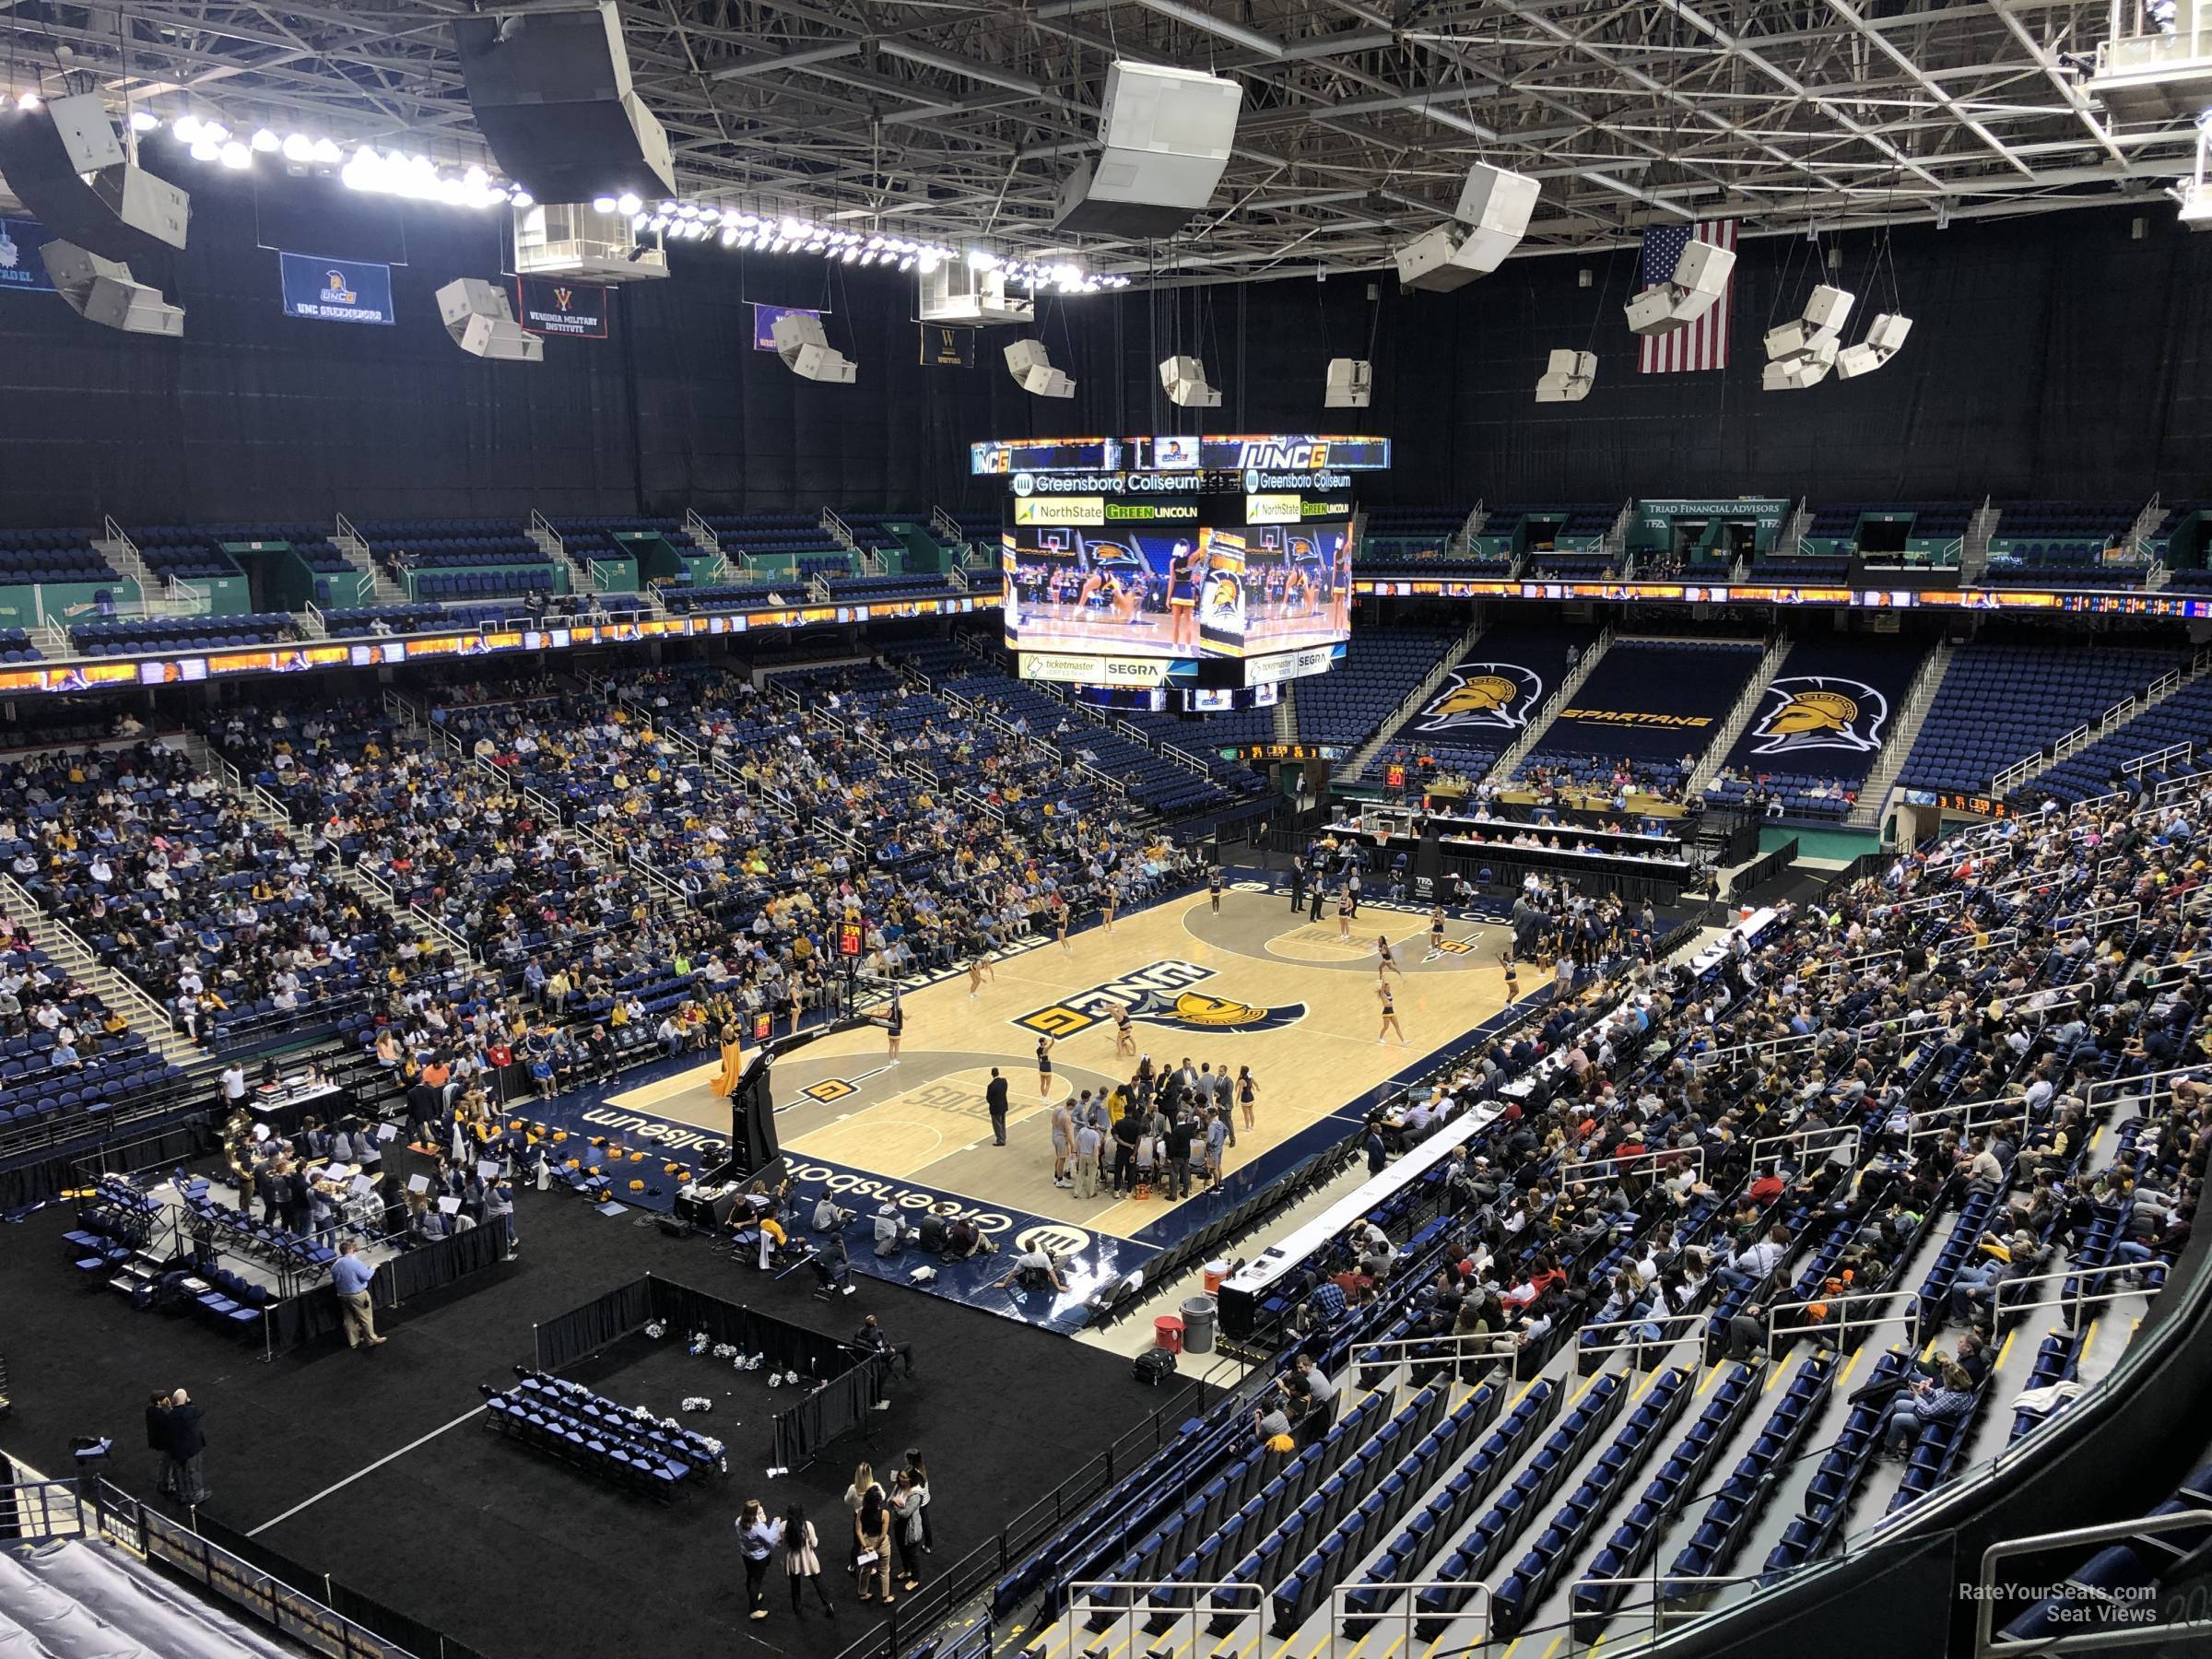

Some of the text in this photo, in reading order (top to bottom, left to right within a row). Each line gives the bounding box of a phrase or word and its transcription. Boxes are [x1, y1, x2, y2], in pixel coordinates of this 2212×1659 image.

[297, 303, 318, 314] UNC
[530, 312, 597, 325] VIRGINIA MILITARY
[546, 323, 584, 333] INSTITUTE
[1245, 445, 1327, 468] UNCG
[1036, 474, 1200, 491] Greensboro Coliseum
[1260, 472, 1350, 488] Greensboro Coliseum
[1041, 506, 1102, 518] NorthState
[1262, 502, 1300, 515] NorthState
[1650, 504, 1780, 513] TRIAD FINANCIAL ADVISORS
[1644, 519, 1667, 528] TFA
[2084, 599, 2088, 607] 1
[2109, 600, 2118, 608] 13
[2136, 601, 2146, 610] 14
[2160, 603, 2170, 612] 21
[1300, 653, 1326, 666] SEGRA
[1046, 661, 1093, 671] ticketmaster
[1109, 664, 1158, 676] SEGRA
[1263, 659, 1292, 672] ticketmaster
[1559, 709, 1713, 727] SPARTANS
[1388, 773, 1401, 784] 30
[1416, 877, 1433, 885] TFA
[843, 926, 860, 935] 3:59
[842, 935, 857, 952] 30
[1022, 961, 1207, 1036] UNCG
[758, 1026, 768, 1036] 30
[582, 1108, 735, 1152] oliseum
